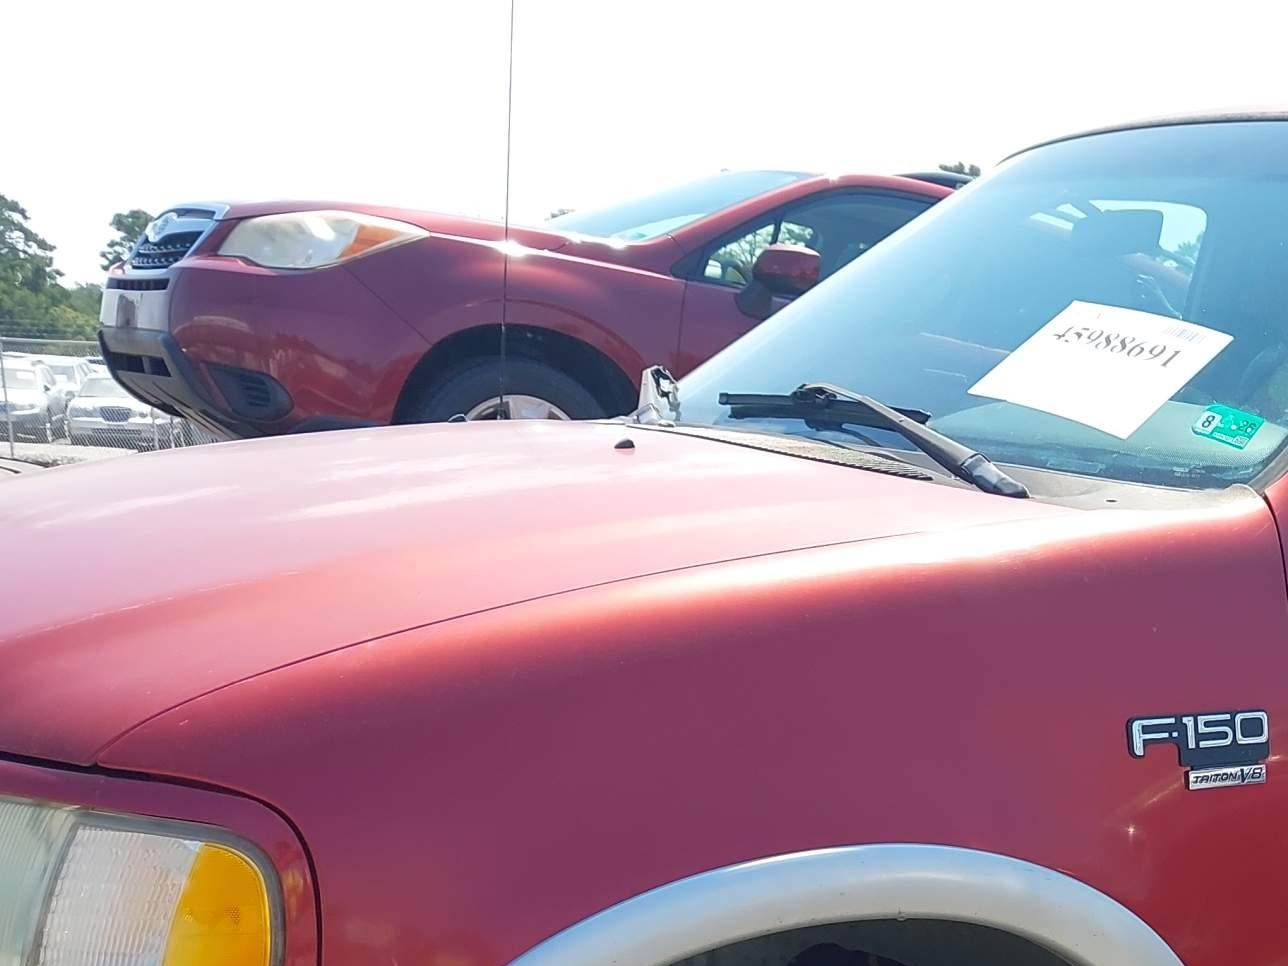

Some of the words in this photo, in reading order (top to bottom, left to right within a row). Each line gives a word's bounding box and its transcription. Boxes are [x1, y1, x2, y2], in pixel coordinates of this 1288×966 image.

[1053, 325, 1182, 368] 45988691
[1201, 414, 1216, 429] 8
[1192, 771, 1238, 785] TRITON
[1238, 766, 1264, 784] V8
